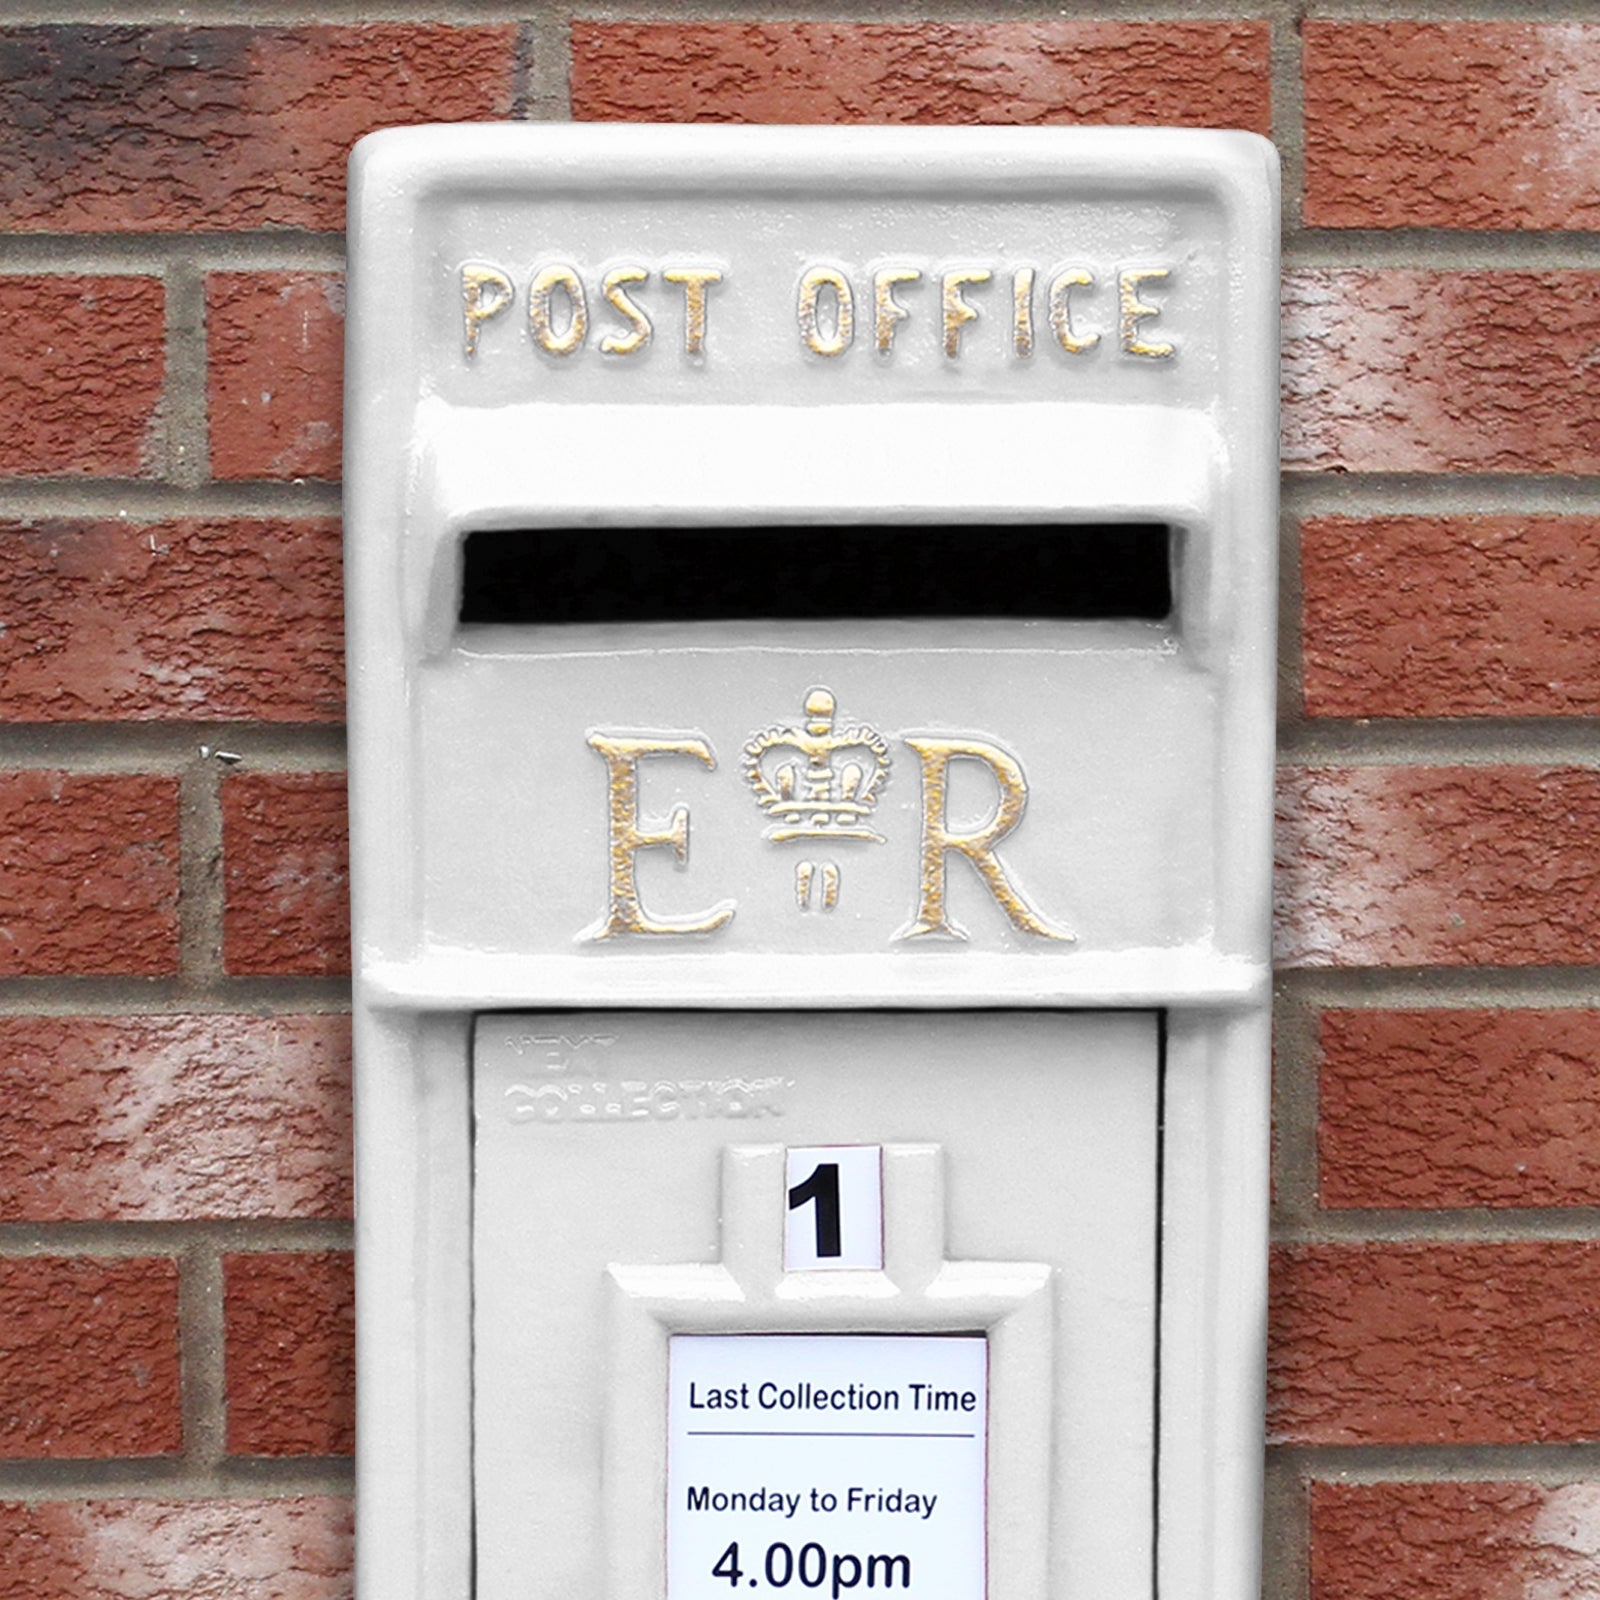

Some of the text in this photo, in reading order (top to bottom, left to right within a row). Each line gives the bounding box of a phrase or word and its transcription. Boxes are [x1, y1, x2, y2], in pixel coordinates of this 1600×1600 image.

[461, 265, 1179, 361] POST OFFICE
[573, 726, 1080, 943] E R
[788, 1163, 841, 1258] 1
[689, 1382, 977, 1411] Last Collection Time
[687, 1486, 937, 1519] Monday to Friday
[711, 1541, 911, 1600] 4.00pm
